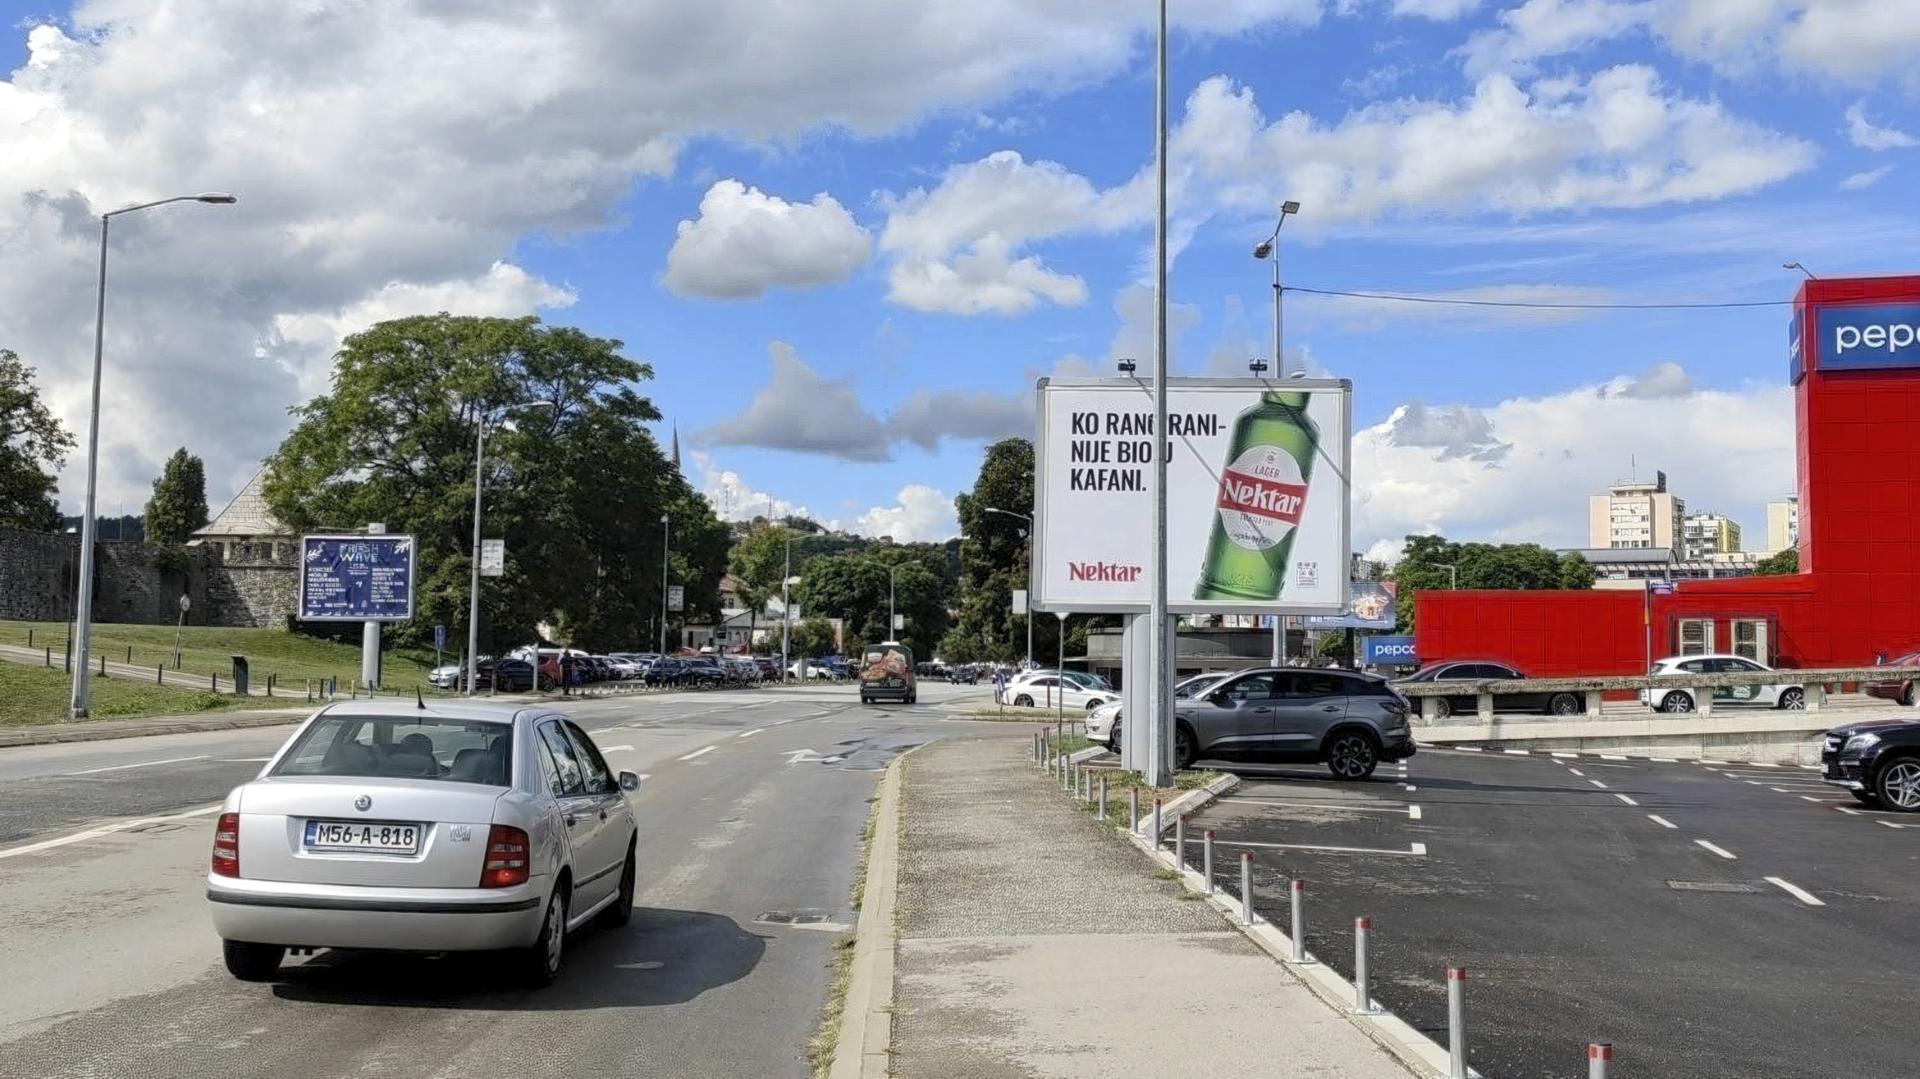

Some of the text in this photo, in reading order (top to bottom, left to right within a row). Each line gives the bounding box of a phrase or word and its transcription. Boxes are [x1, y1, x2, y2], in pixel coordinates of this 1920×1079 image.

[1836, 323, 1920, 354] pep
[1072, 412, 1099, 435] KO
[1168, 412, 1227, 437] RANI-
[1071, 440, 1111, 463] NIJE
[1117, 440, 1152, 464] BIO
[1070, 468, 1147, 491] KAFANI.
[1222, 477, 1302, 516] Nektar
[339, 552, 379, 563] WAVE
[1068, 561, 1142, 582] Nektar
[317, 825, 414, 846] M56-A-818
